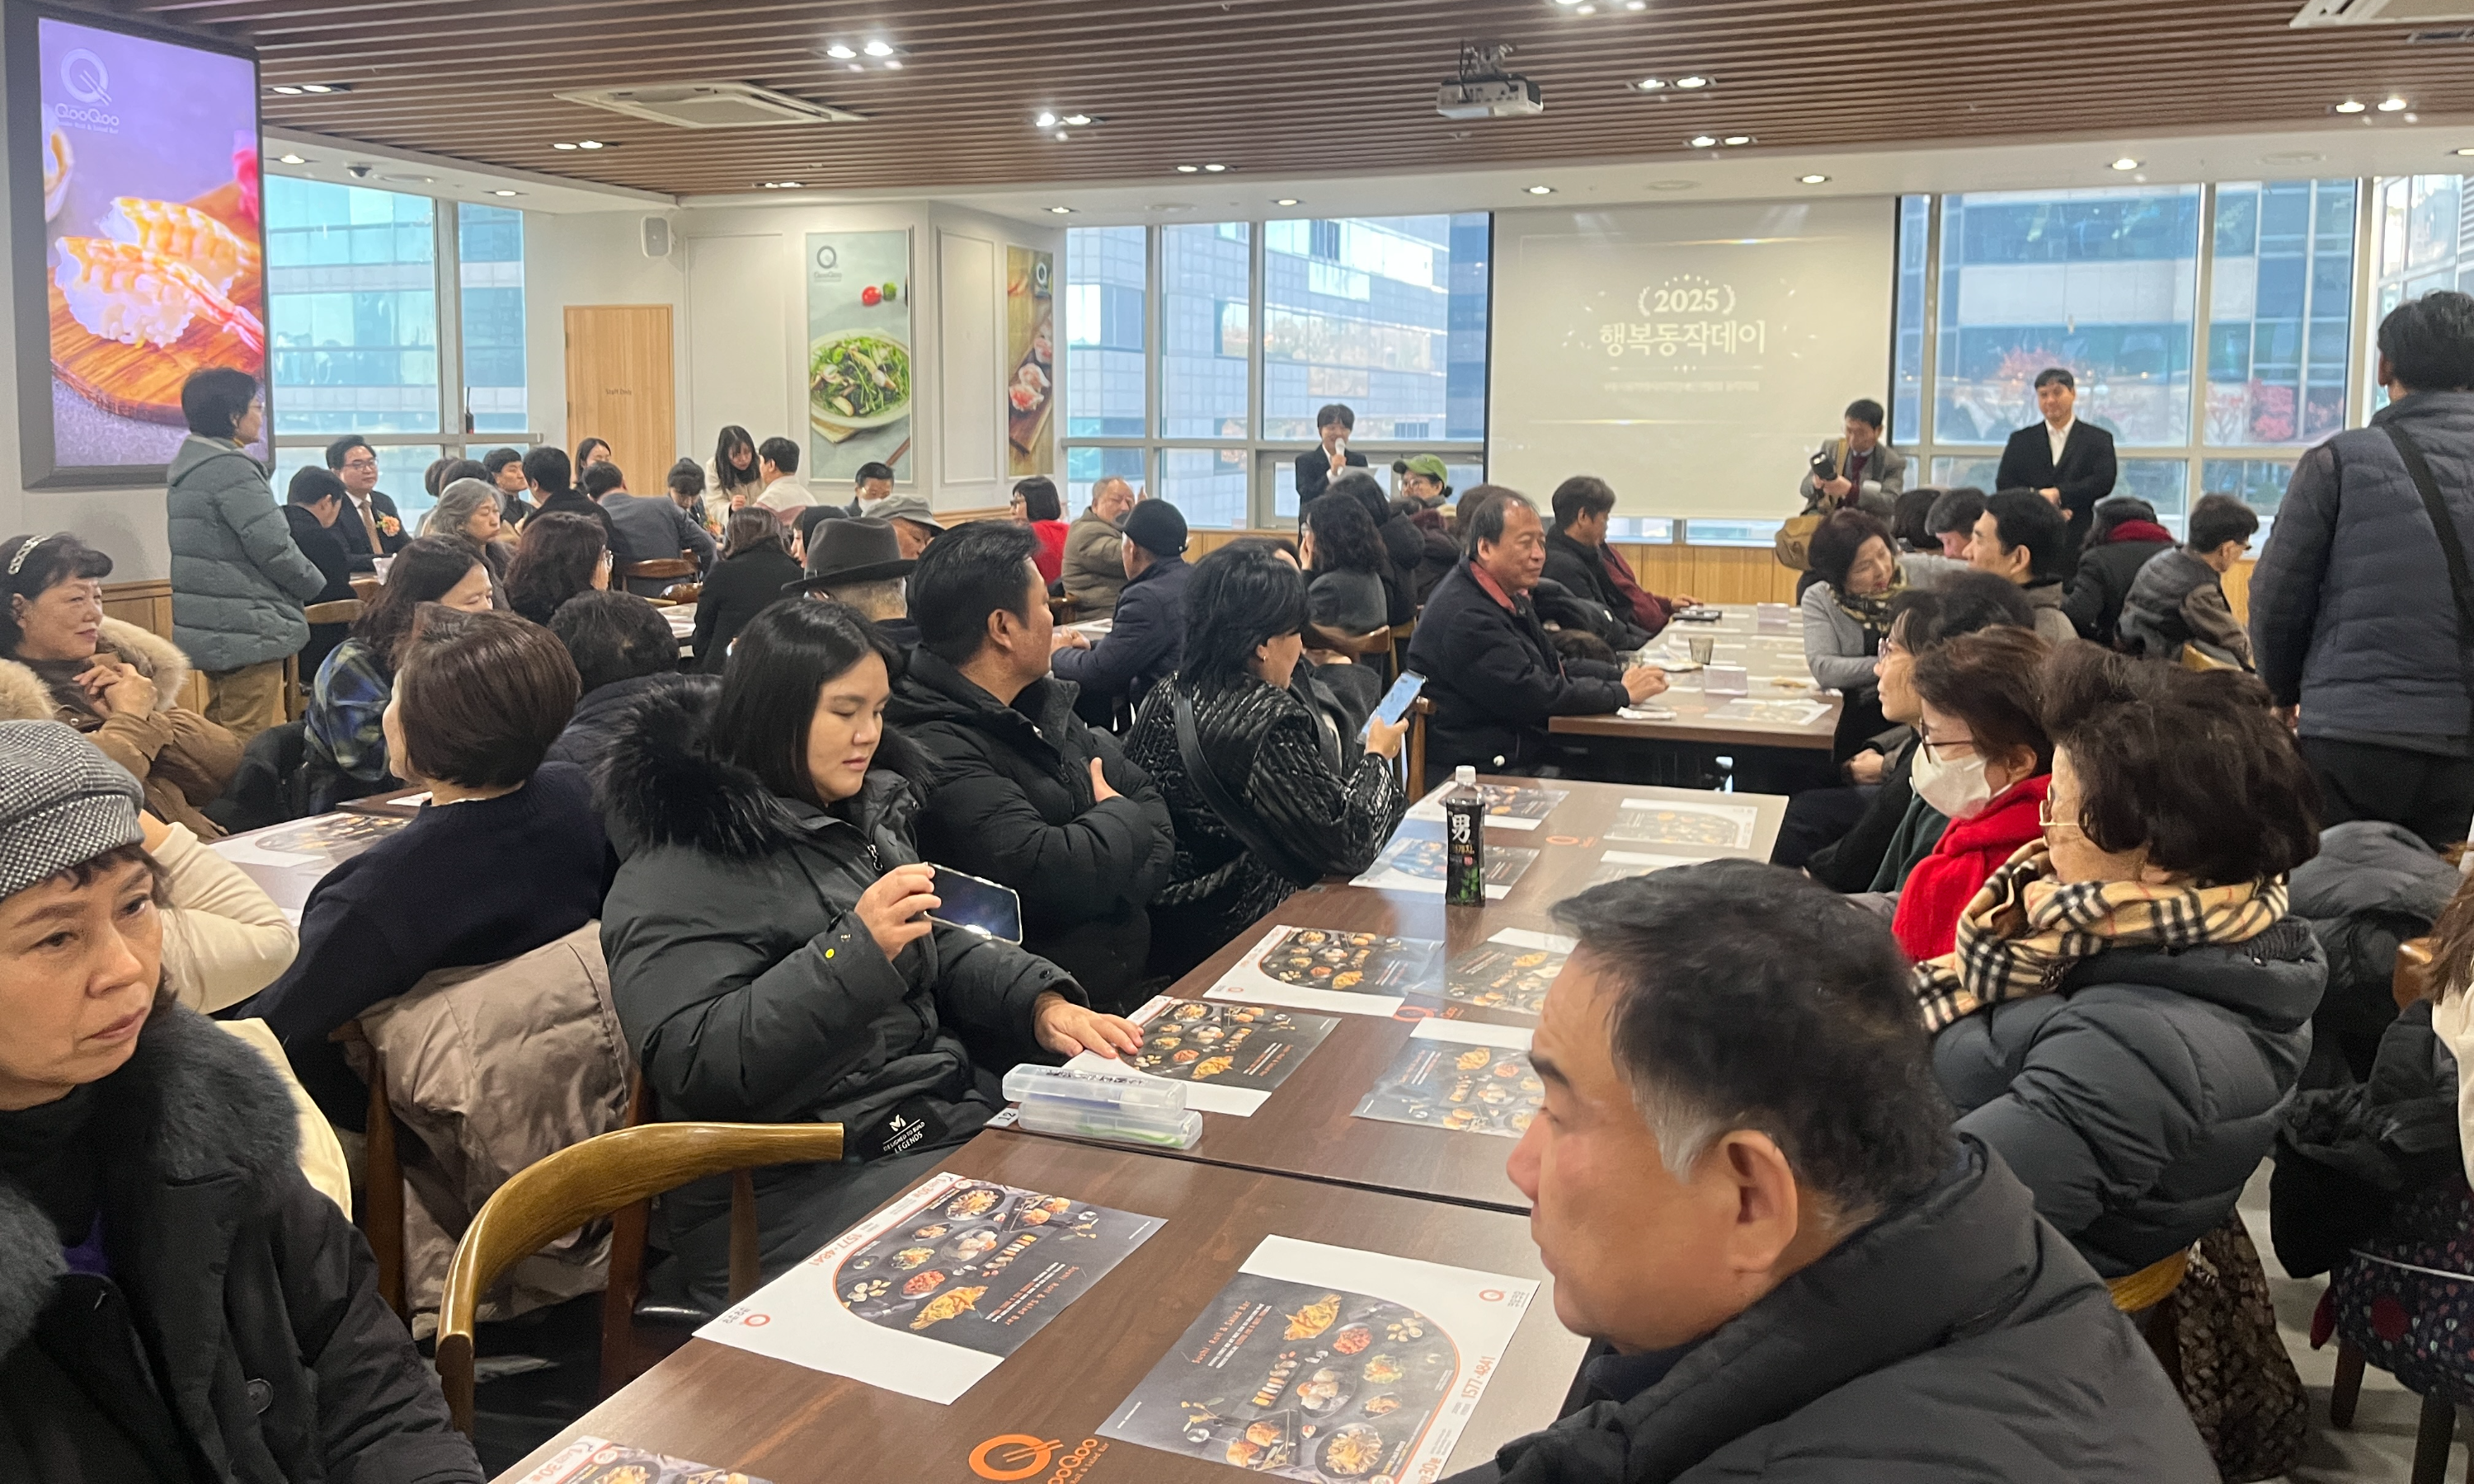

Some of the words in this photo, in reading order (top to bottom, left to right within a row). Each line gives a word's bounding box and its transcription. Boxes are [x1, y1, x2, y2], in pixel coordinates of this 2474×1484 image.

[55, 102, 120, 126] QooQoo
[1653, 289, 1719, 313] 2025
[1599, 319, 1766, 357] 행복동작데이
[1451, 813, 1471, 844] 男
[998, 1111, 1016, 1121] 12
[882, 1134, 907, 1152] DESIGNED
[906, 1129, 914, 1137] TO
[912, 1121, 925, 1133] BUILD
[894, 1130, 924, 1154] LEGENDS
[1047, 1438, 1098, 1484] ooQoo
